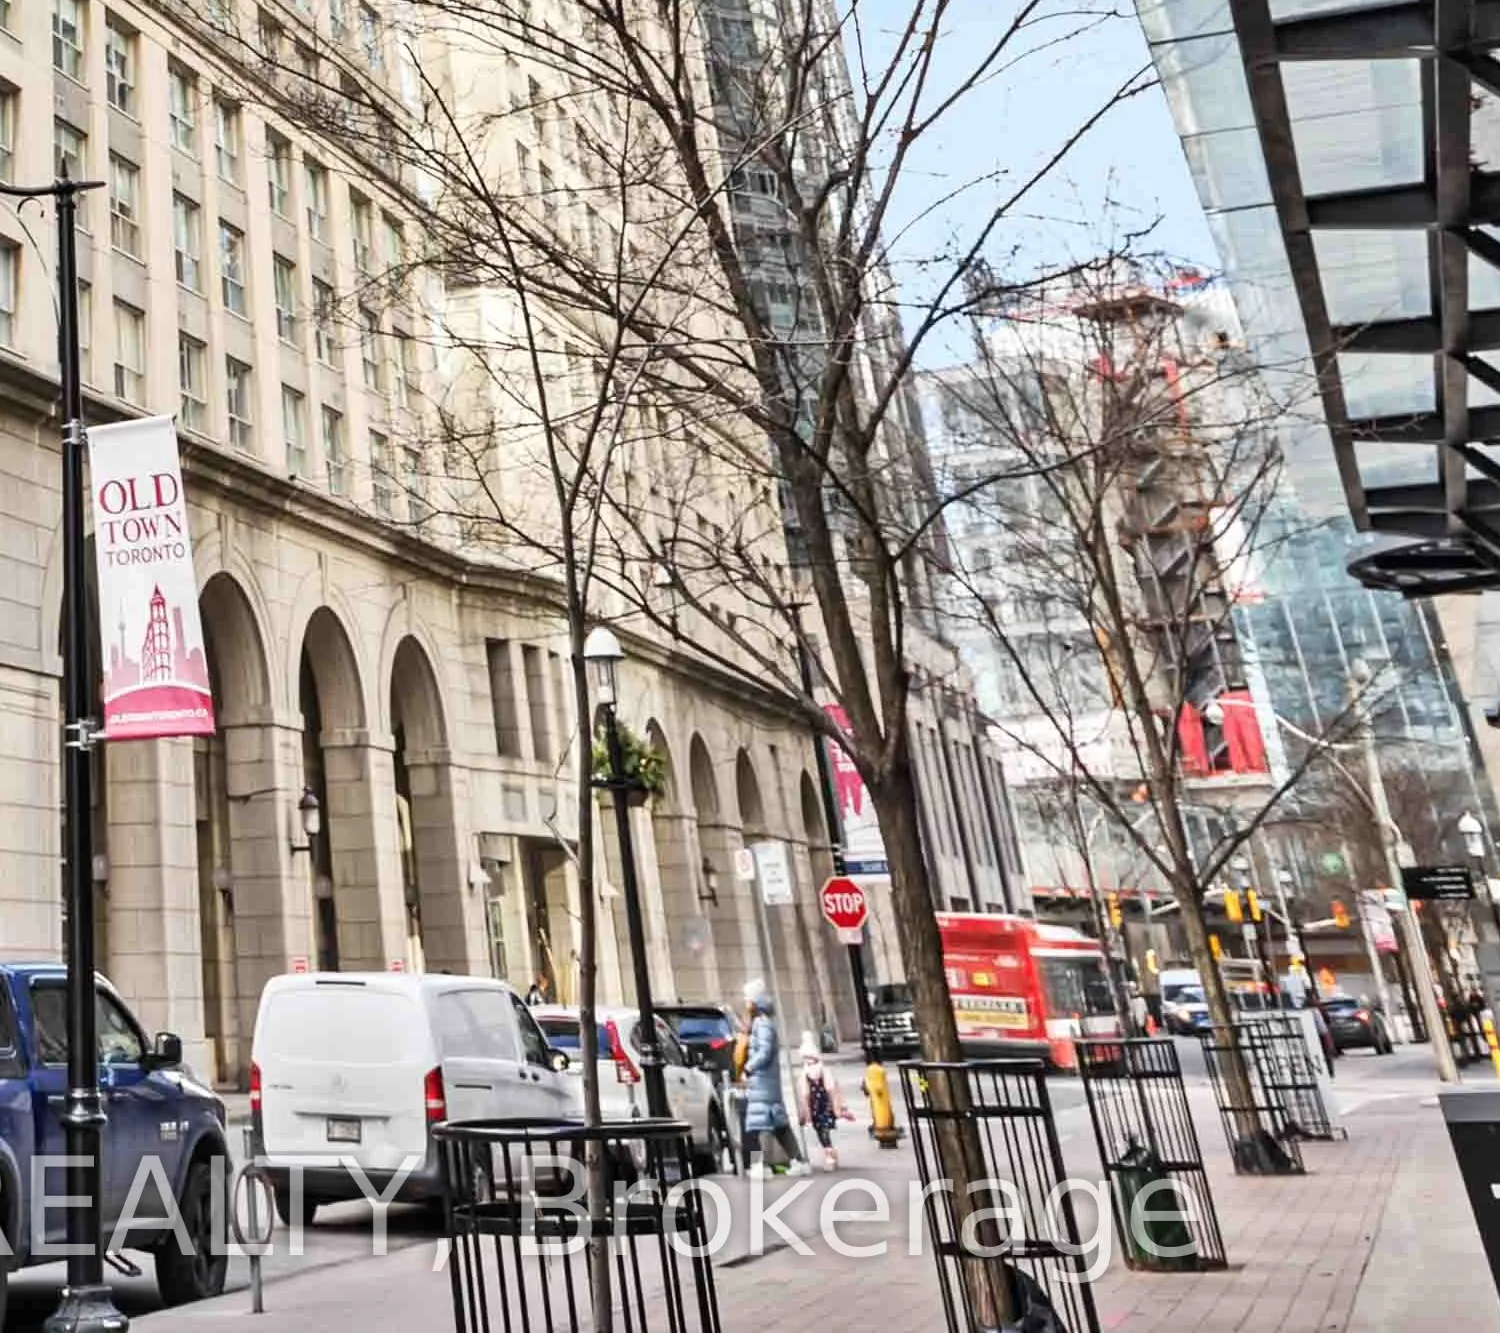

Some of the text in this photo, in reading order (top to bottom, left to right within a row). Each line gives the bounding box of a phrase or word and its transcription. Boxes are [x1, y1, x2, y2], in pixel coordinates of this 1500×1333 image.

[99, 472, 179, 515] OLD
[102, 515, 182, 545] TOWN
[105, 542, 186, 567] TORONTO
[825, 892, 863, 915] STOP
